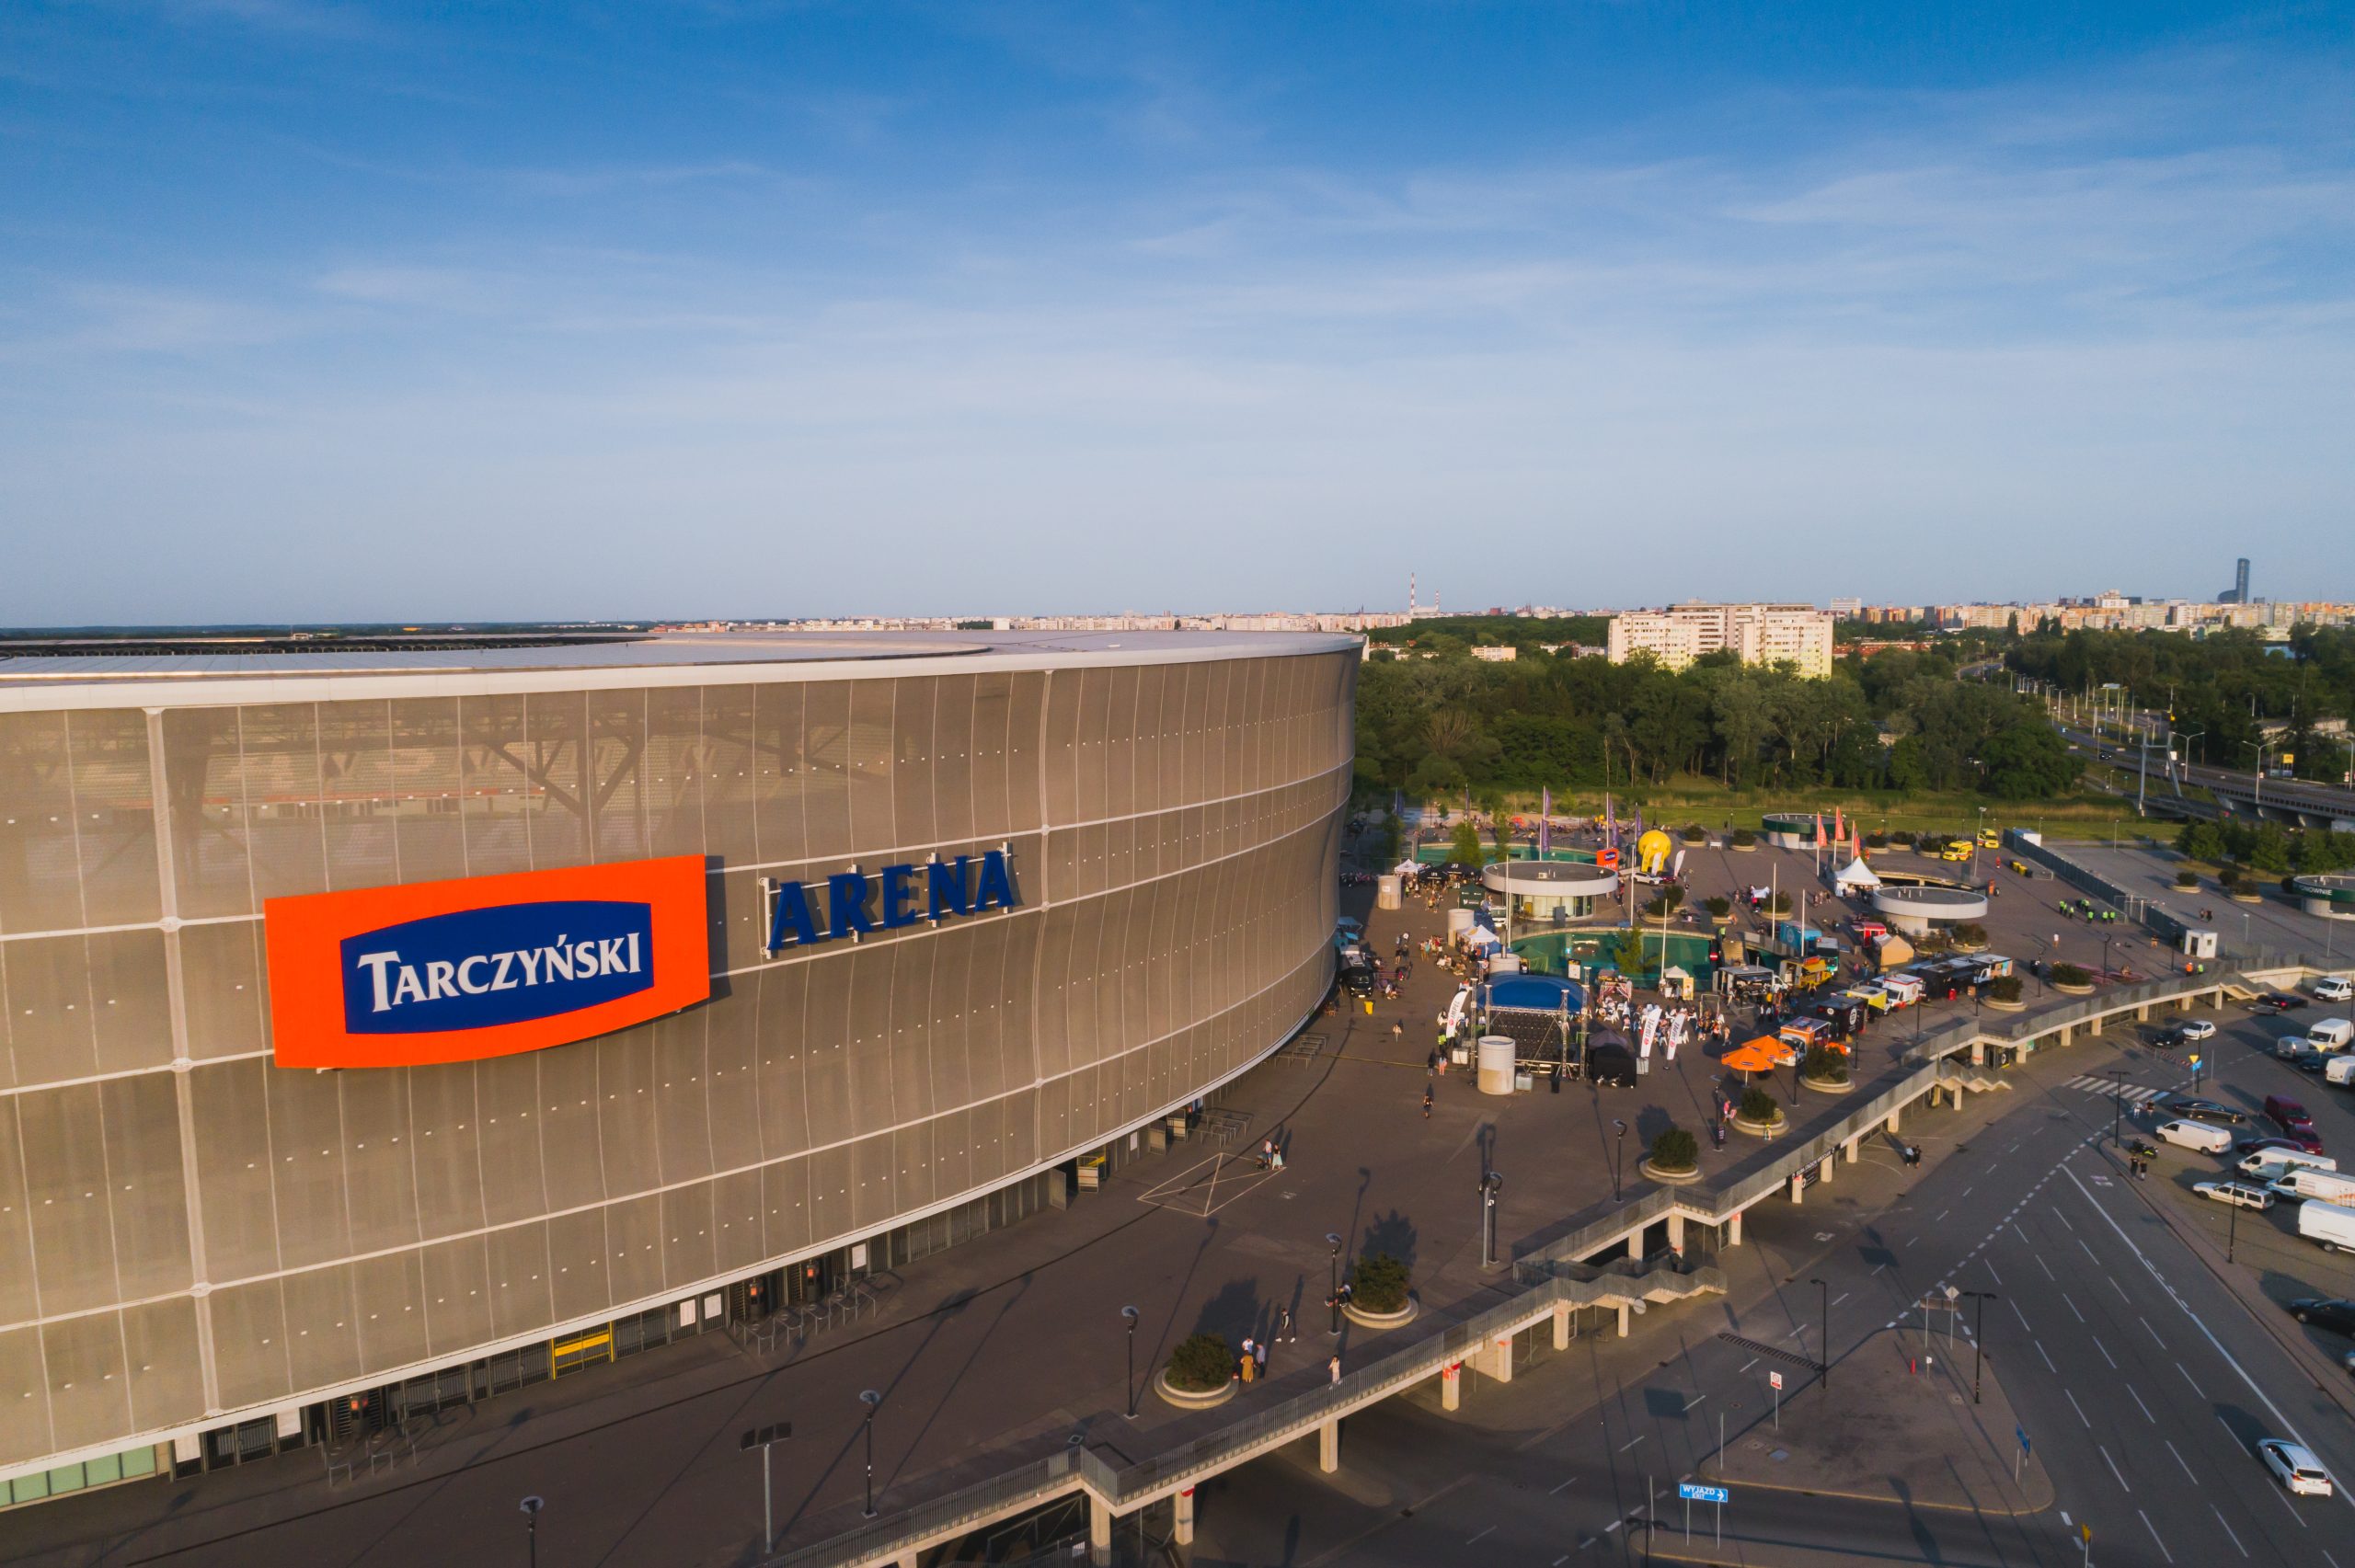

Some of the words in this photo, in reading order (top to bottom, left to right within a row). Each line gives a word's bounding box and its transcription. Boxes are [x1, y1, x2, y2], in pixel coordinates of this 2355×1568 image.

[767, 851, 1015, 950] ARENA
[357, 932, 641, 1013] TARCZYŃSKI
[1683, 1485, 1716, 1495] WYJAZD
